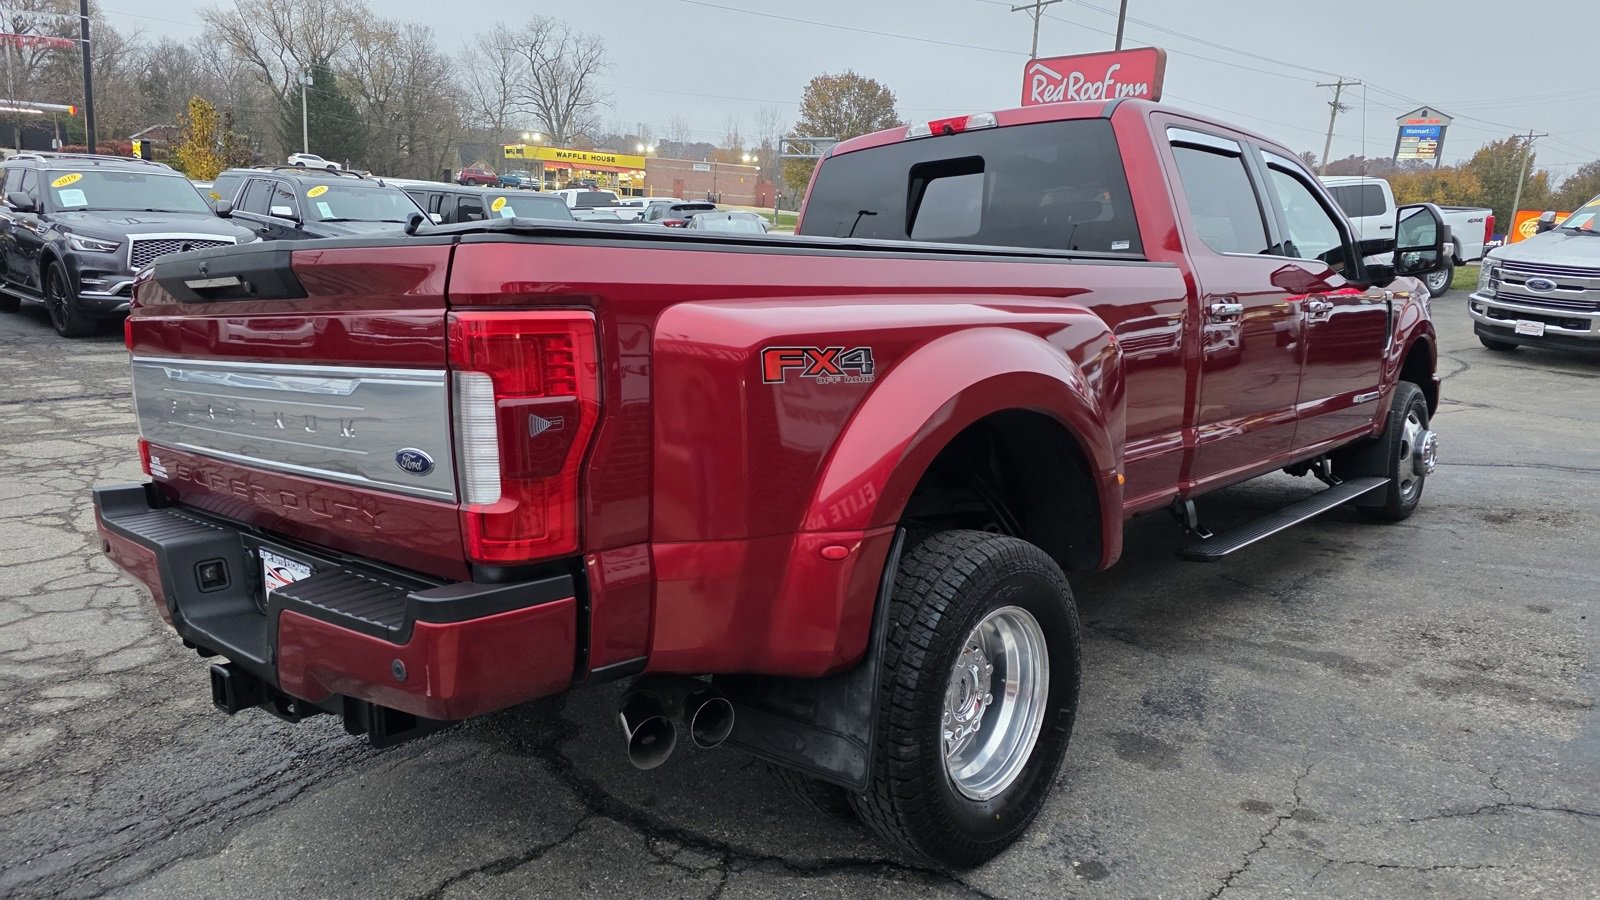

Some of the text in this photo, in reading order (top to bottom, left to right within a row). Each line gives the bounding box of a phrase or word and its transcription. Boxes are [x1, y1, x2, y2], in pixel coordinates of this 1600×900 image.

[1031, 74, 1067, 103] Red
[556, 151, 616, 163] WAFFLE HOUSE
[761, 346, 875, 384] FX4
[816, 376, 875, 385] OFF ROAD
[280, 489, 387, 529] DUTY
